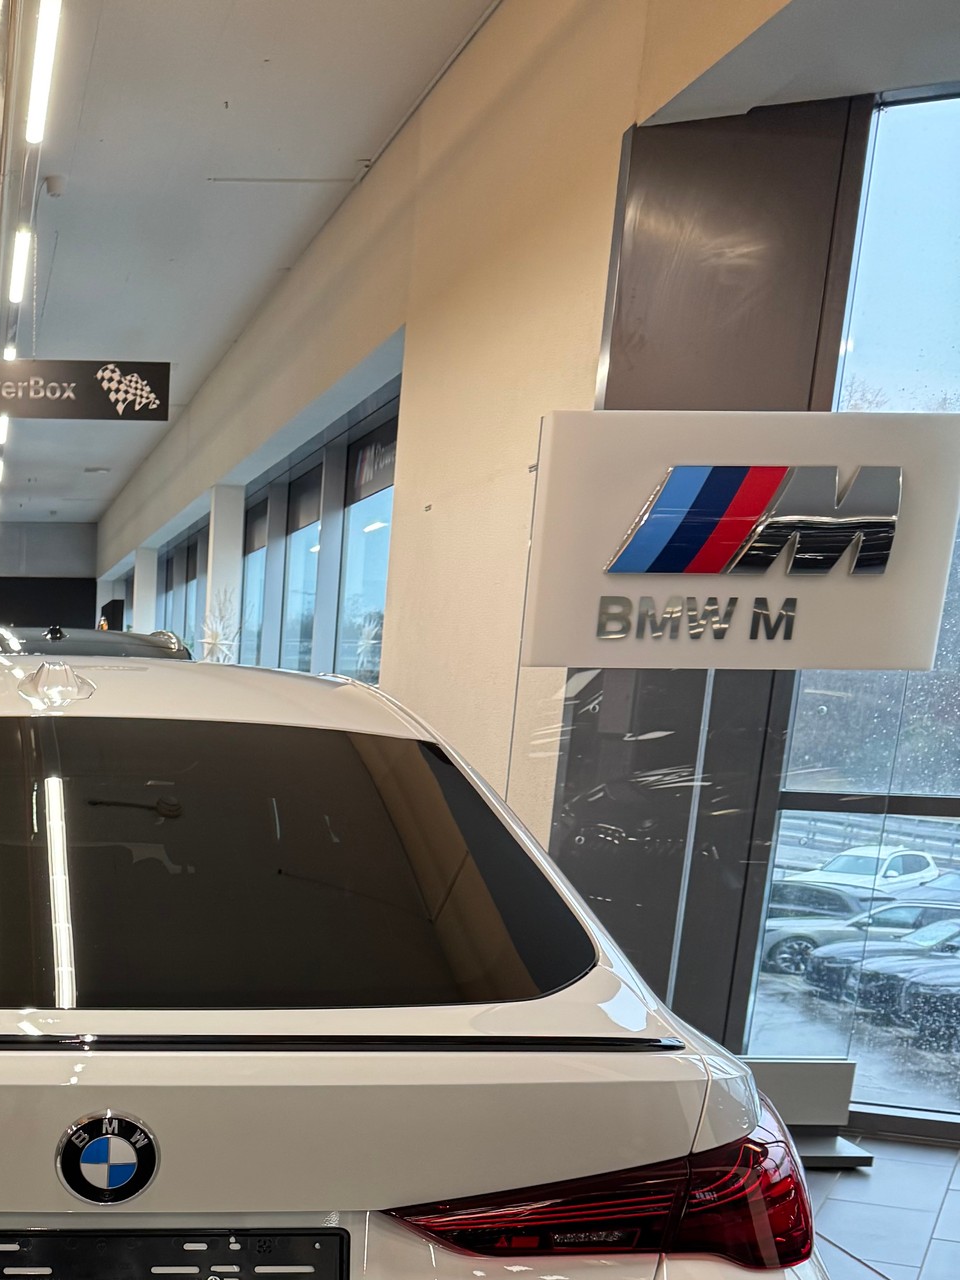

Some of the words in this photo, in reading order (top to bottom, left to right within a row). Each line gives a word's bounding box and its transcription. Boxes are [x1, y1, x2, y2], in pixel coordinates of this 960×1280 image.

[727, 465, 903, 576] M
[596, 595, 739, 640] BMW
[748, 597, 798, 640] M
[71, 1118, 150, 1149] BMW
